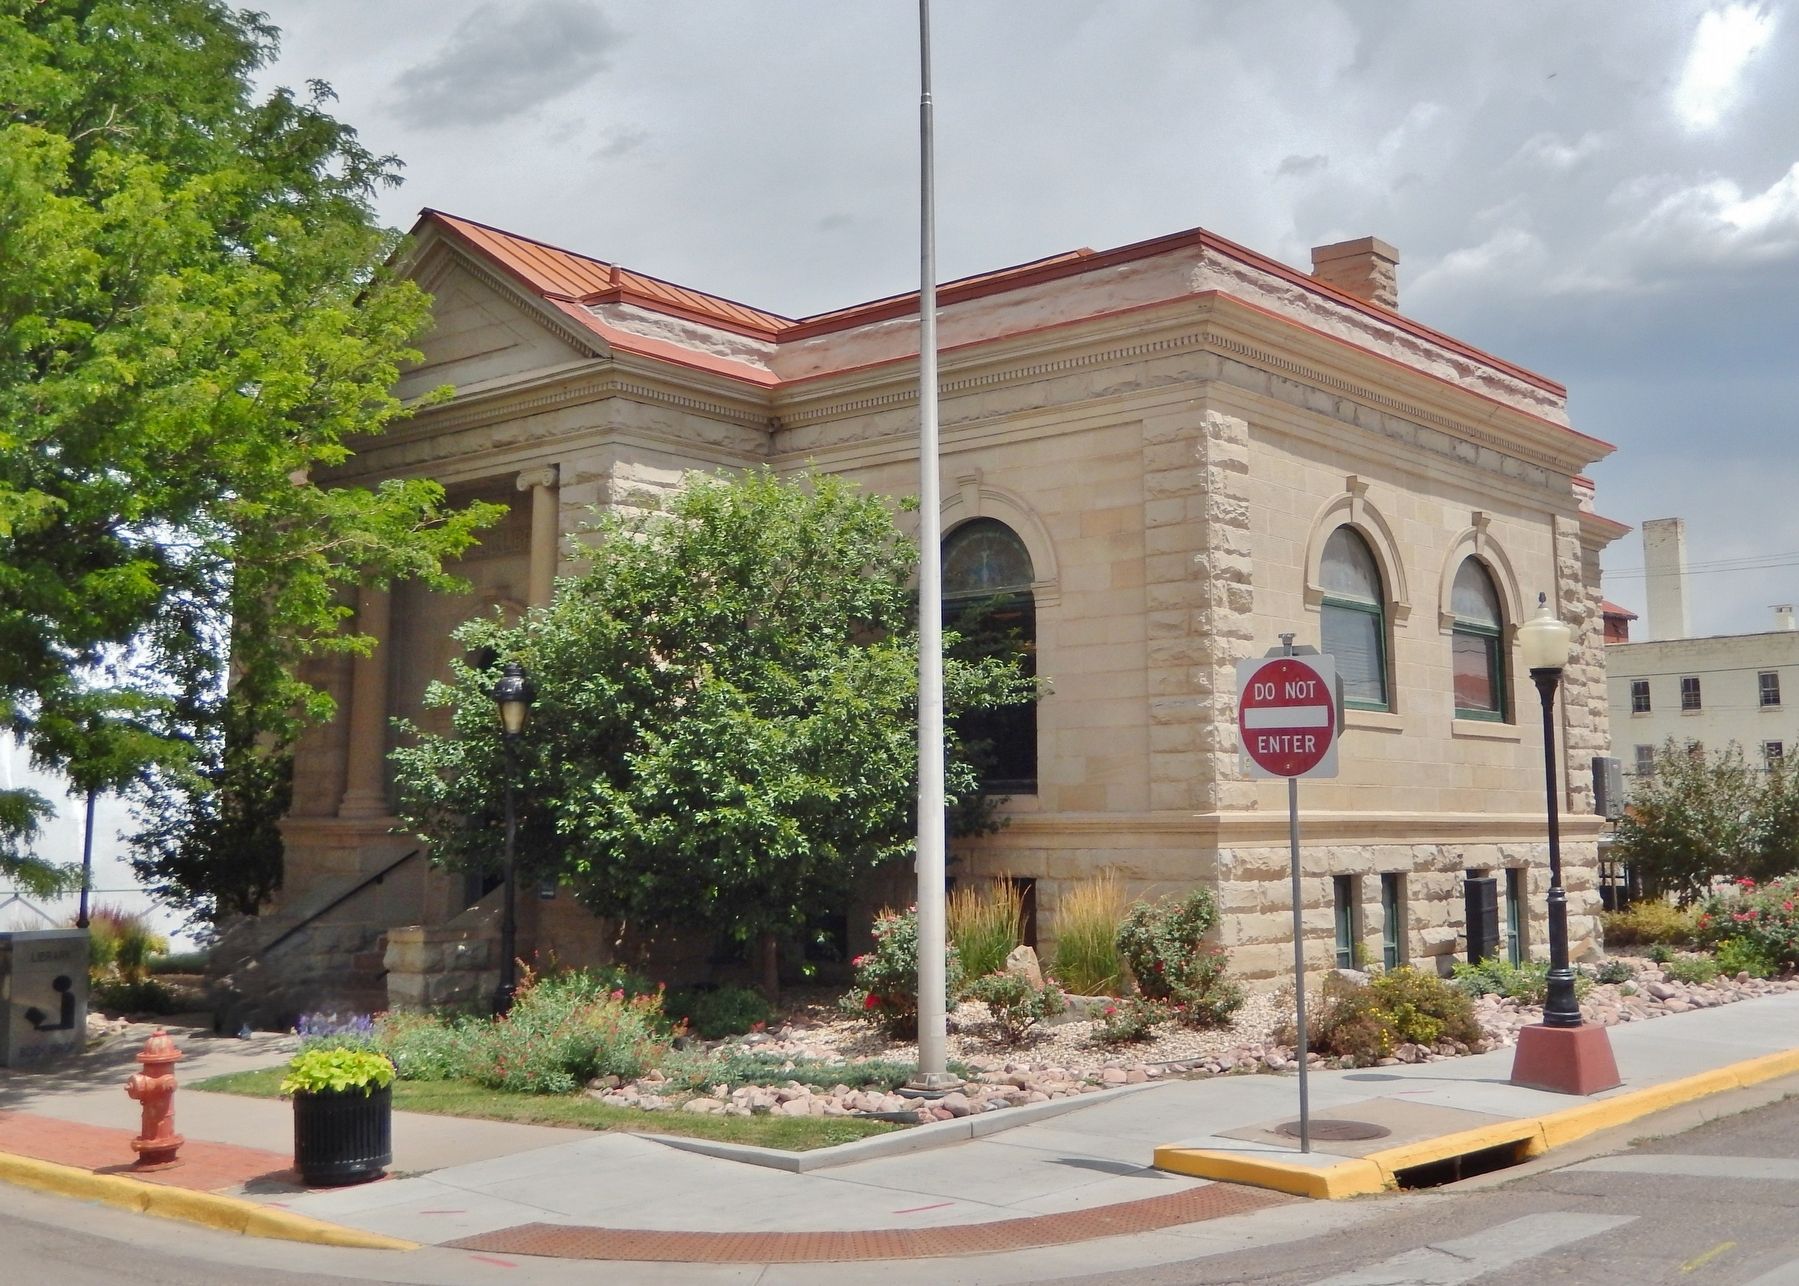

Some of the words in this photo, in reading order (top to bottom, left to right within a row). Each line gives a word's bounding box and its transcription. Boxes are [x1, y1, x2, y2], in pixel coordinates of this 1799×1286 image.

[1254, 682, 1275, 700] DO
[1285, 681, 1316, 699] NOT
[1258, 735, 1316, 753] ENTER
